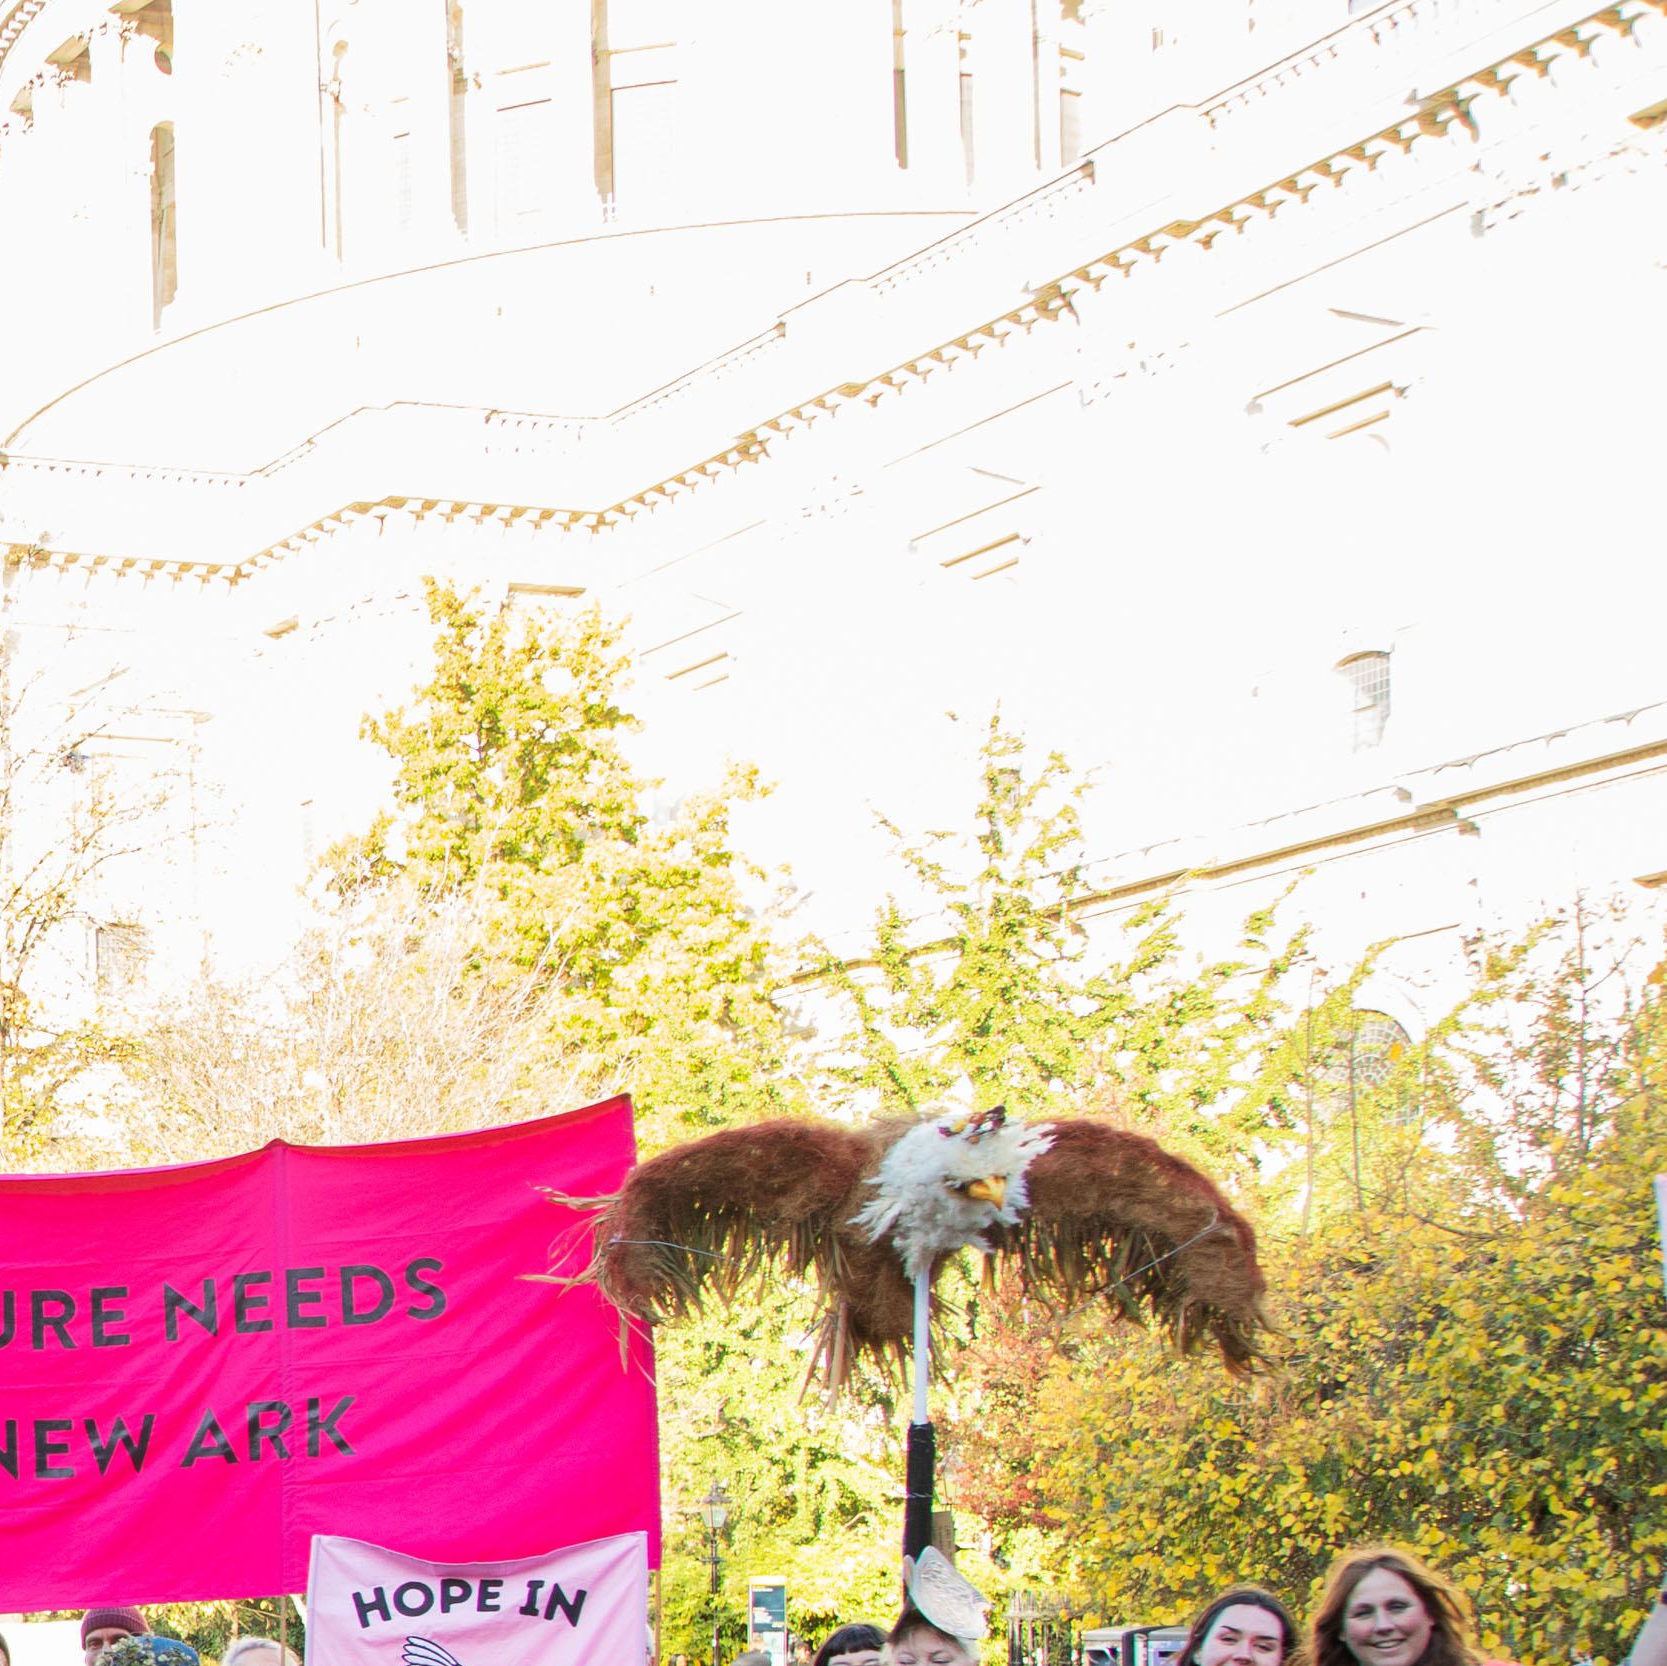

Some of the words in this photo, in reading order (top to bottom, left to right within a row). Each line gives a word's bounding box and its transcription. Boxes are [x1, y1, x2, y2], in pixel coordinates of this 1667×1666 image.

[164, 1257, 448, 1342] NEEDS
[181, 1395, 358, 1468] ARK
[353, 1578, 505, 1628] HOPE
[519, 1580, 588, 1627] IN
